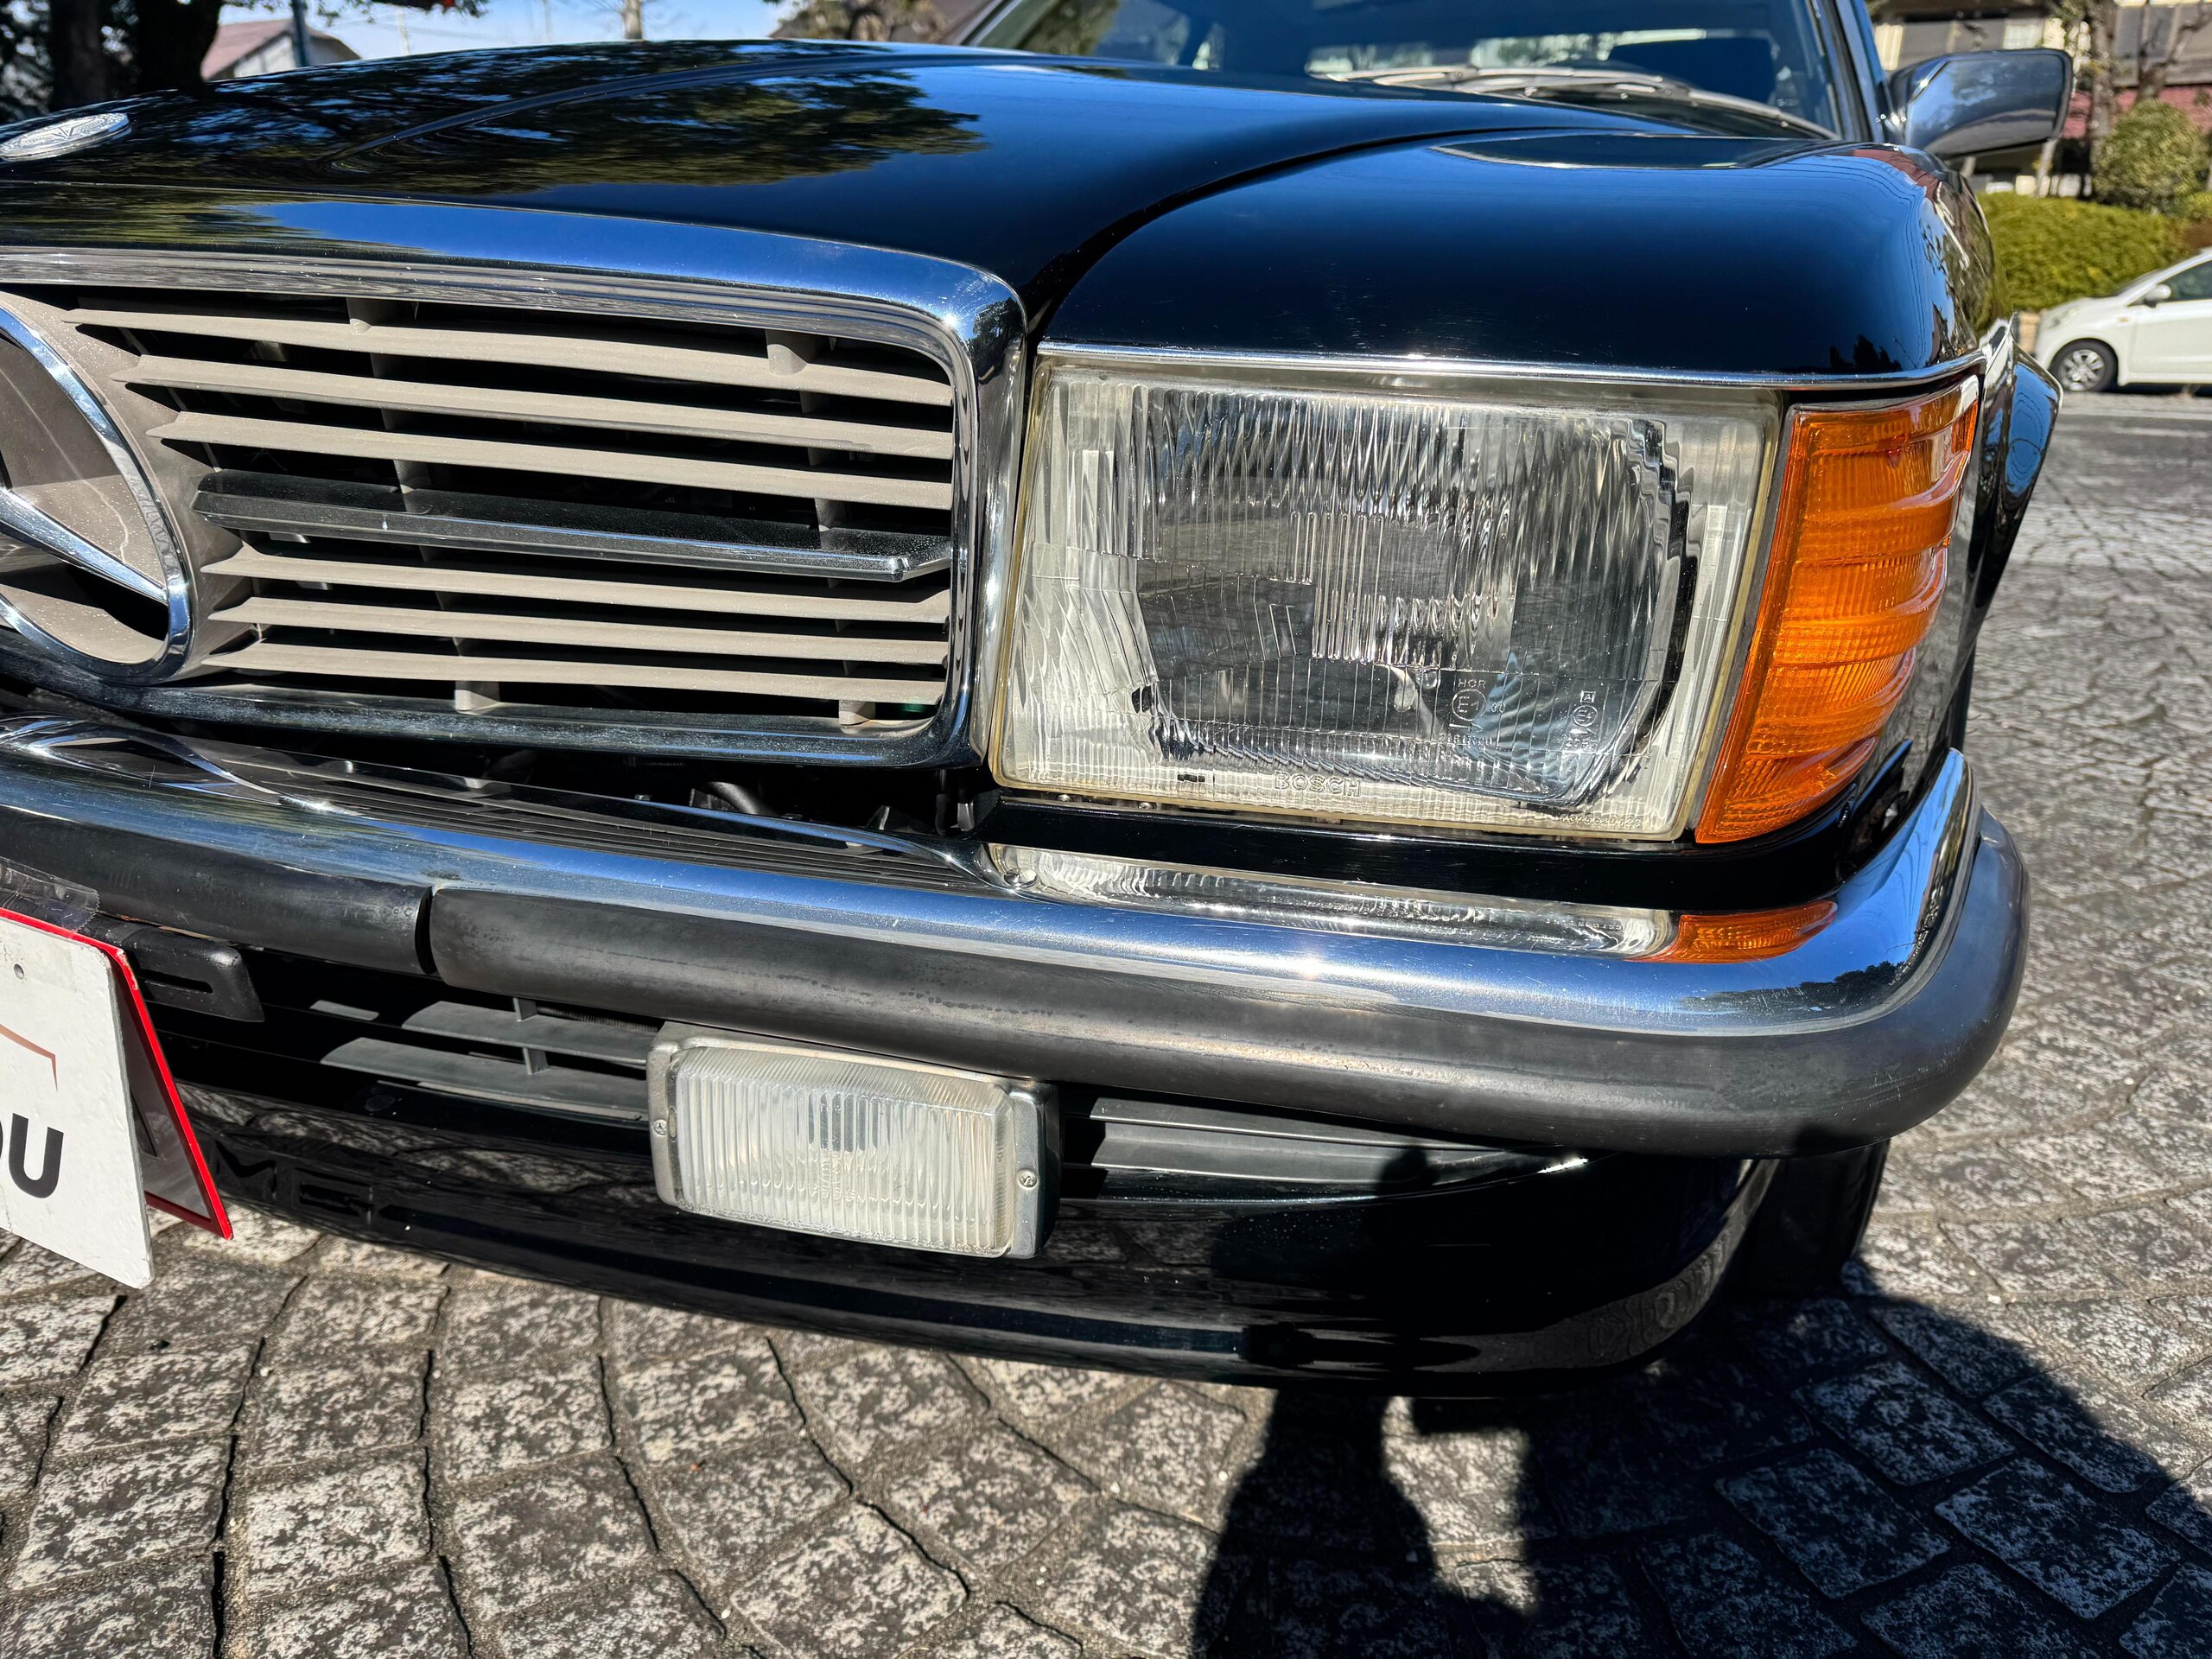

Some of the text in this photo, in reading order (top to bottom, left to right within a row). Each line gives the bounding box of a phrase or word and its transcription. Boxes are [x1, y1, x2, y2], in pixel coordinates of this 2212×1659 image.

[1457, 696, 1479, 713] E1
[1274, 770, 1362, 798] BOSCH
[0, 1113, 64, 1198] U
